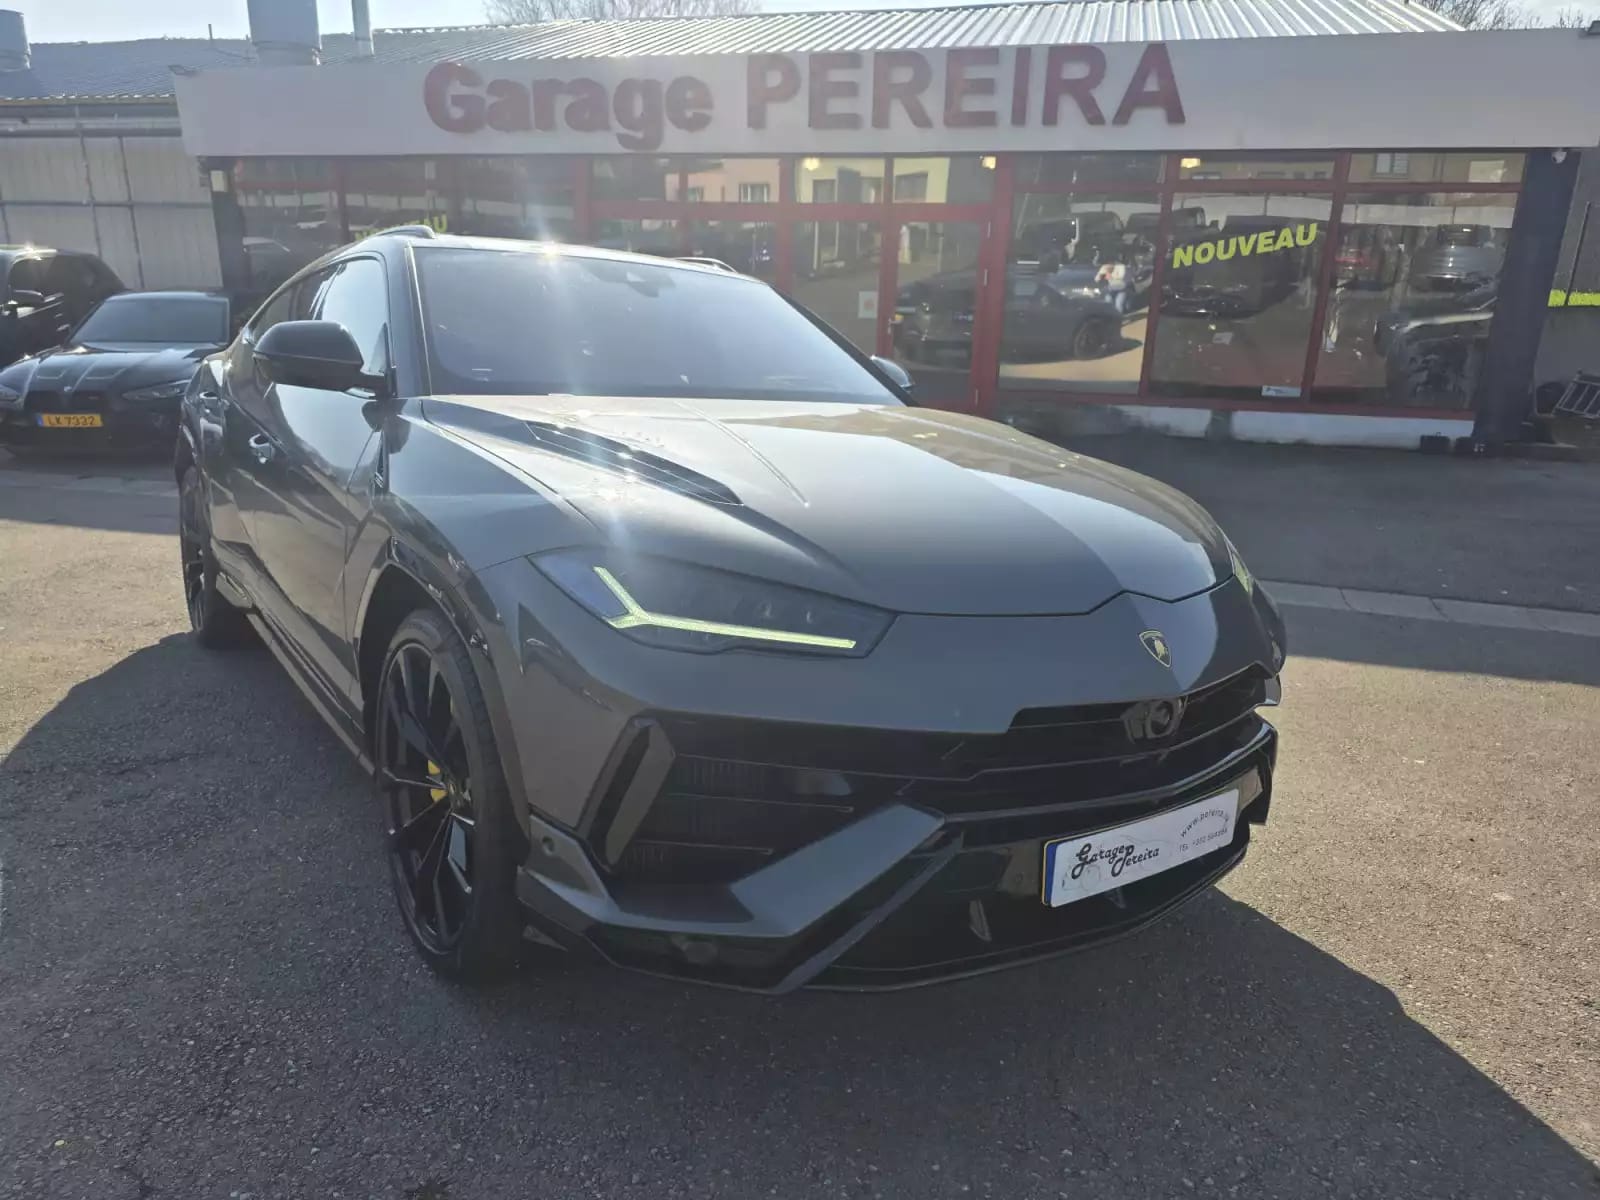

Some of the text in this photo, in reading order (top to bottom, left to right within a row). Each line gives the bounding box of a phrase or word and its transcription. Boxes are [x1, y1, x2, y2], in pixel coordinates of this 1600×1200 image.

[423, 43, 1187, 151] Garage PEREIRA
[1172, 222, 1318, 269] NOUVEAU
[1071, 842, 1125, 880] Garage
[1111, 843, 1160, 878] Pereira
